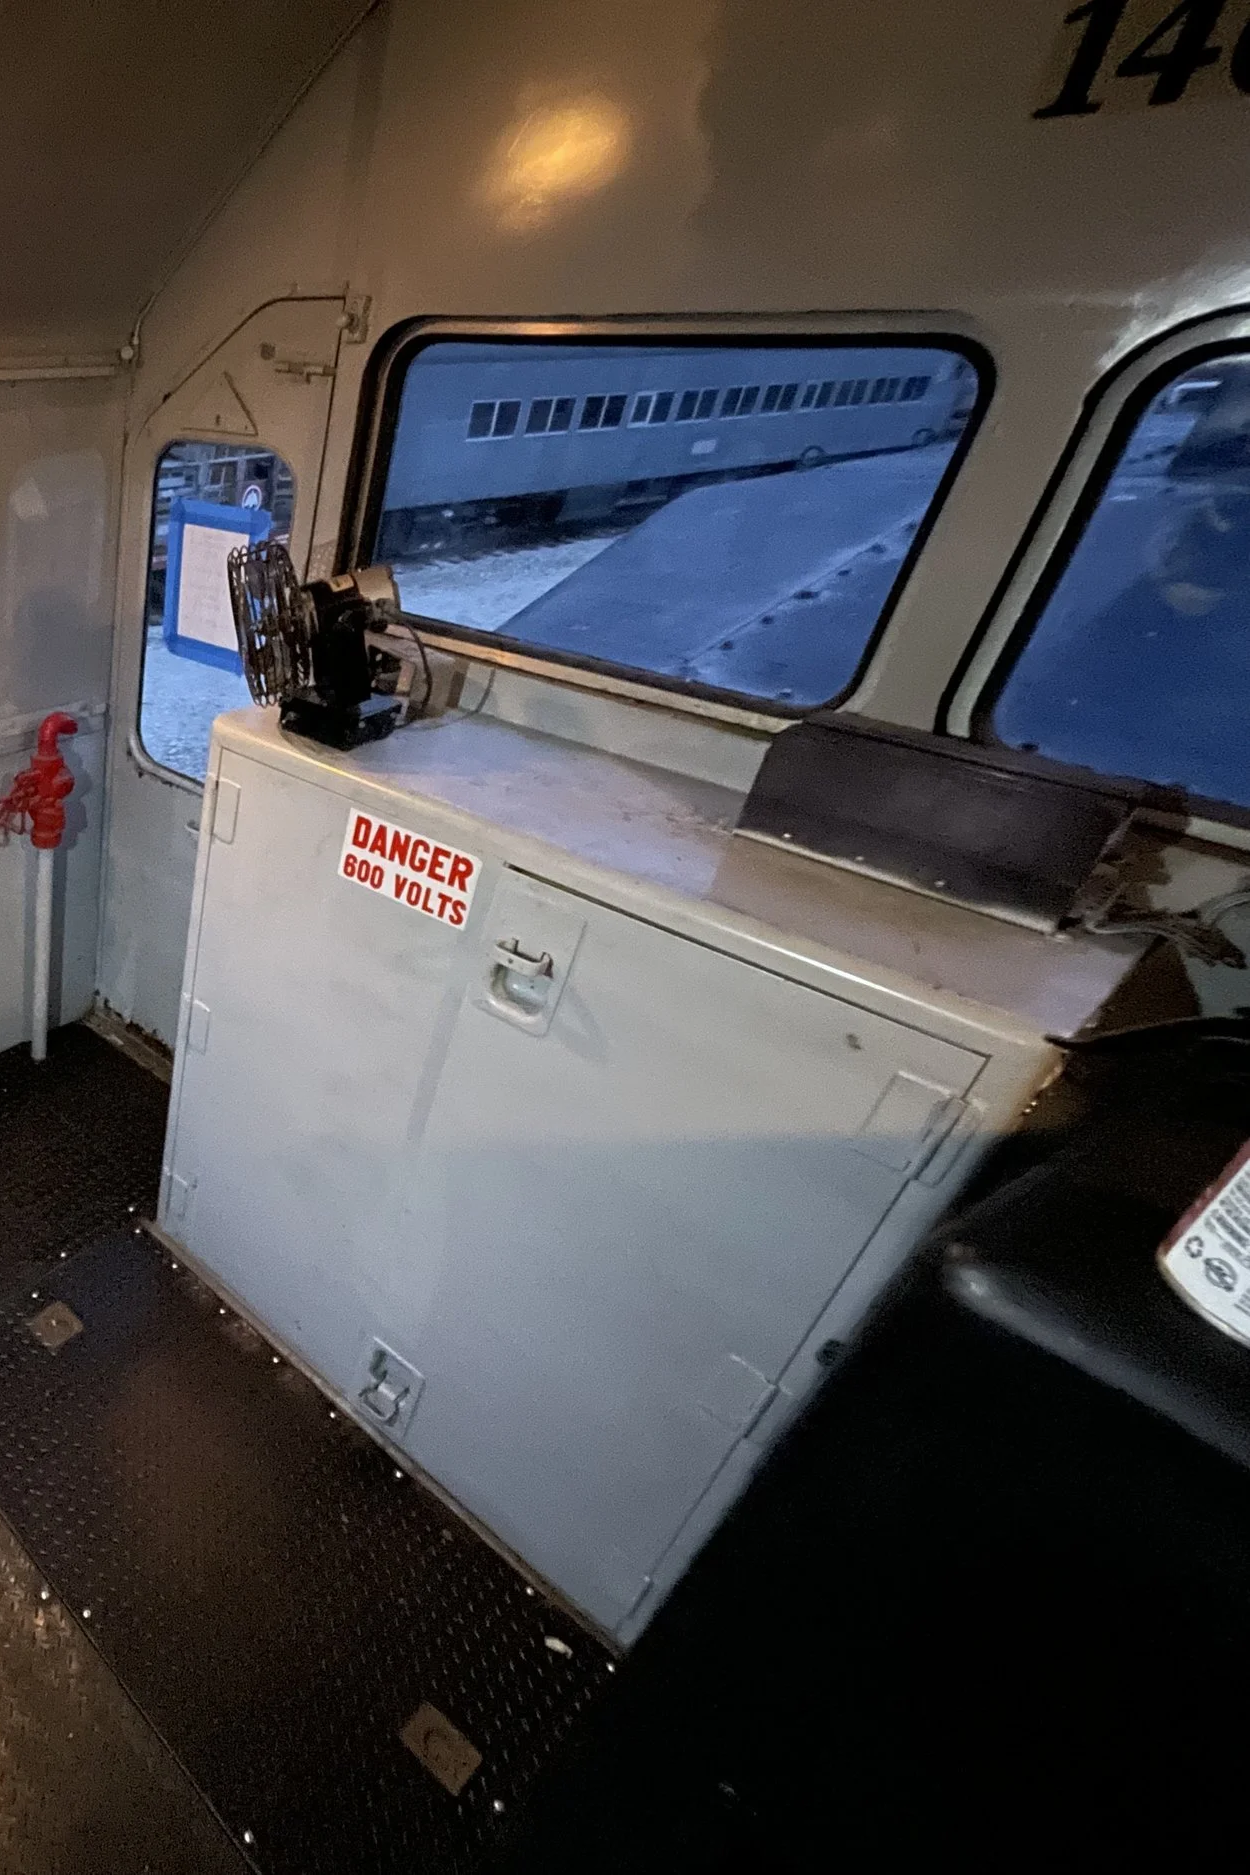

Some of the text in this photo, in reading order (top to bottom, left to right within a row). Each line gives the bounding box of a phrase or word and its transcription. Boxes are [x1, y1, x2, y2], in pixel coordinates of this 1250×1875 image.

[1032, 0, 1250, 119] 14
[343, 853, 466, 925] 600 VOLTS
[352, 815, 473, 893] DANGER
